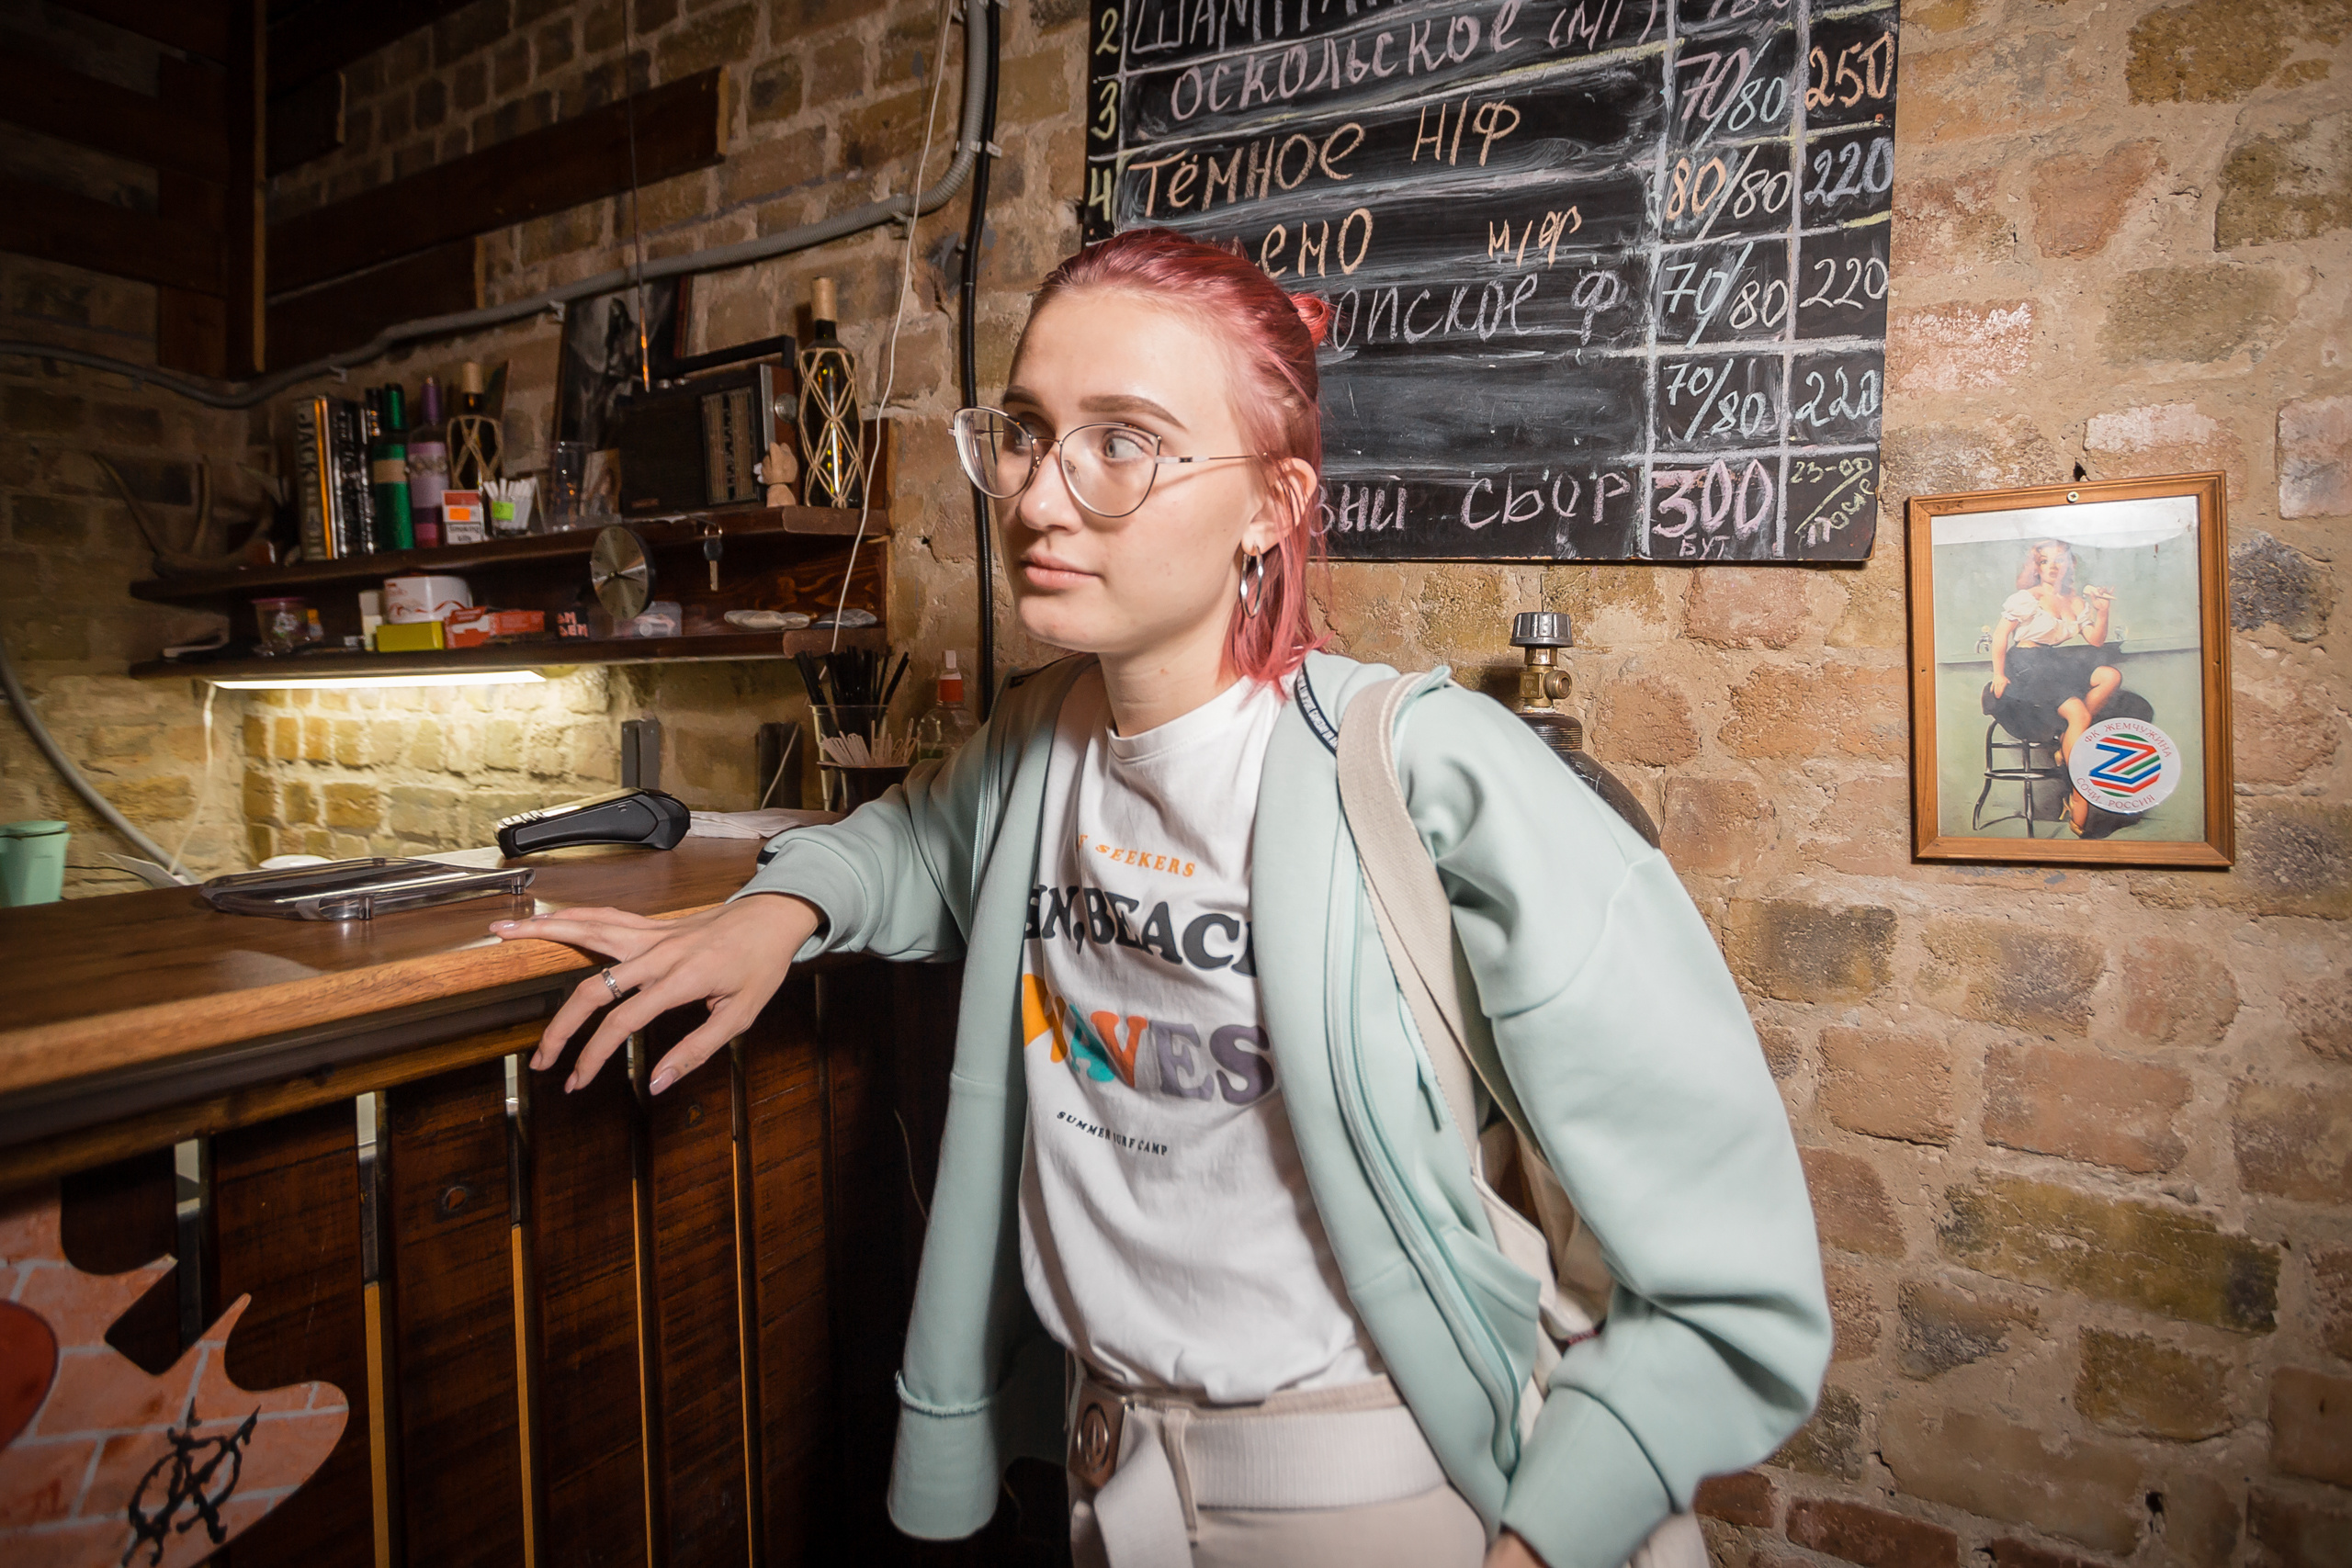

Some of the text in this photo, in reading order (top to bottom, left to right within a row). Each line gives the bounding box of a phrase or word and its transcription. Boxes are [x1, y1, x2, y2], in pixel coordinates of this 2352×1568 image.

[1094, 7, 1119, 55] 2
[1804, 30, 1896, 111] 250
[1091, 81, 1118, 141] 3
[1088, 166, 1113, 222] 4
[1803, 137, 1894, 209] 220
[1798, 255, 1890, 310] 220
[1663, 357, 1881, 443] 70/80 220
[1652, 458, 1774, 540] 300
[2084, 722, 2172, 758] ФК ЖЕМЧУЖИНА
[2108, 794, 2155, 809] РОССИЯ
[1095, 844, 1195, 878] SEEKERS
[1057, 1111, 1112, 1141] SUMMER
[1136, 1139, 1168, 1156] CAMP
